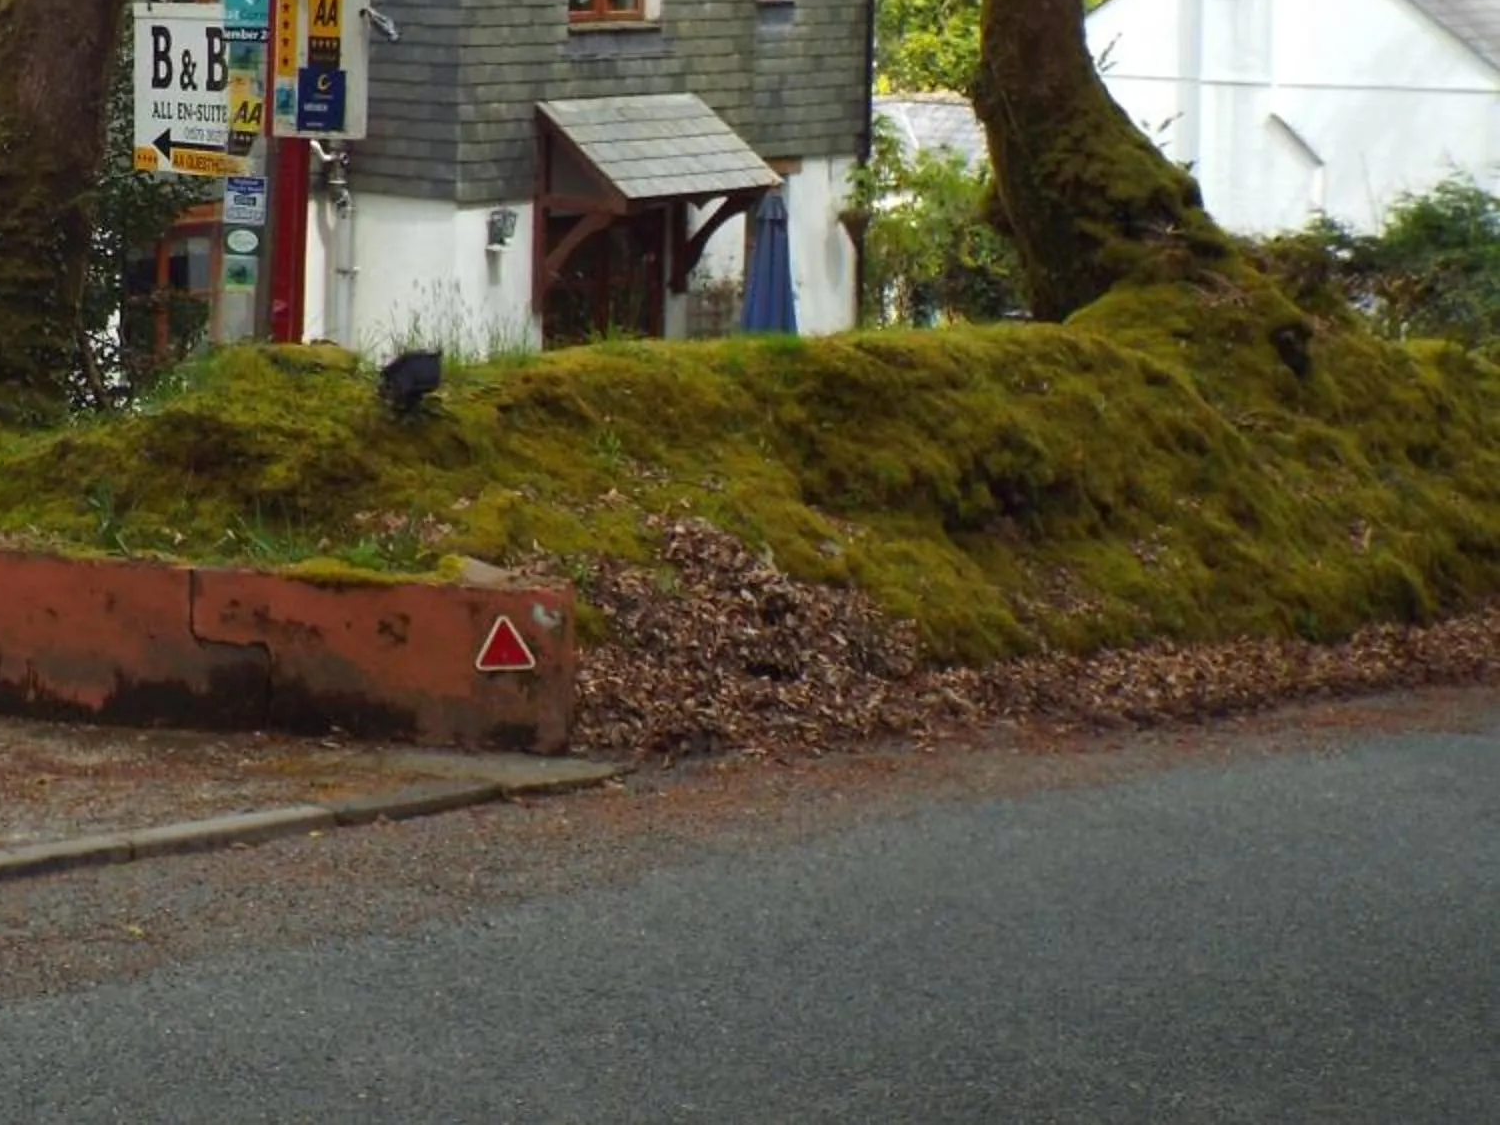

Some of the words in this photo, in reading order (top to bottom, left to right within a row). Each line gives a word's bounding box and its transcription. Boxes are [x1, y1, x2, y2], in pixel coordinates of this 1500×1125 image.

[151, 26, 173, 89] B
[179, 48, 198, 91] &
[205, 26, 229, 91] B
[152, 100, 174, 120] ALL
[177, 102, 228, 124] EN-SUITE
[233, 99, 264, 127] AA
